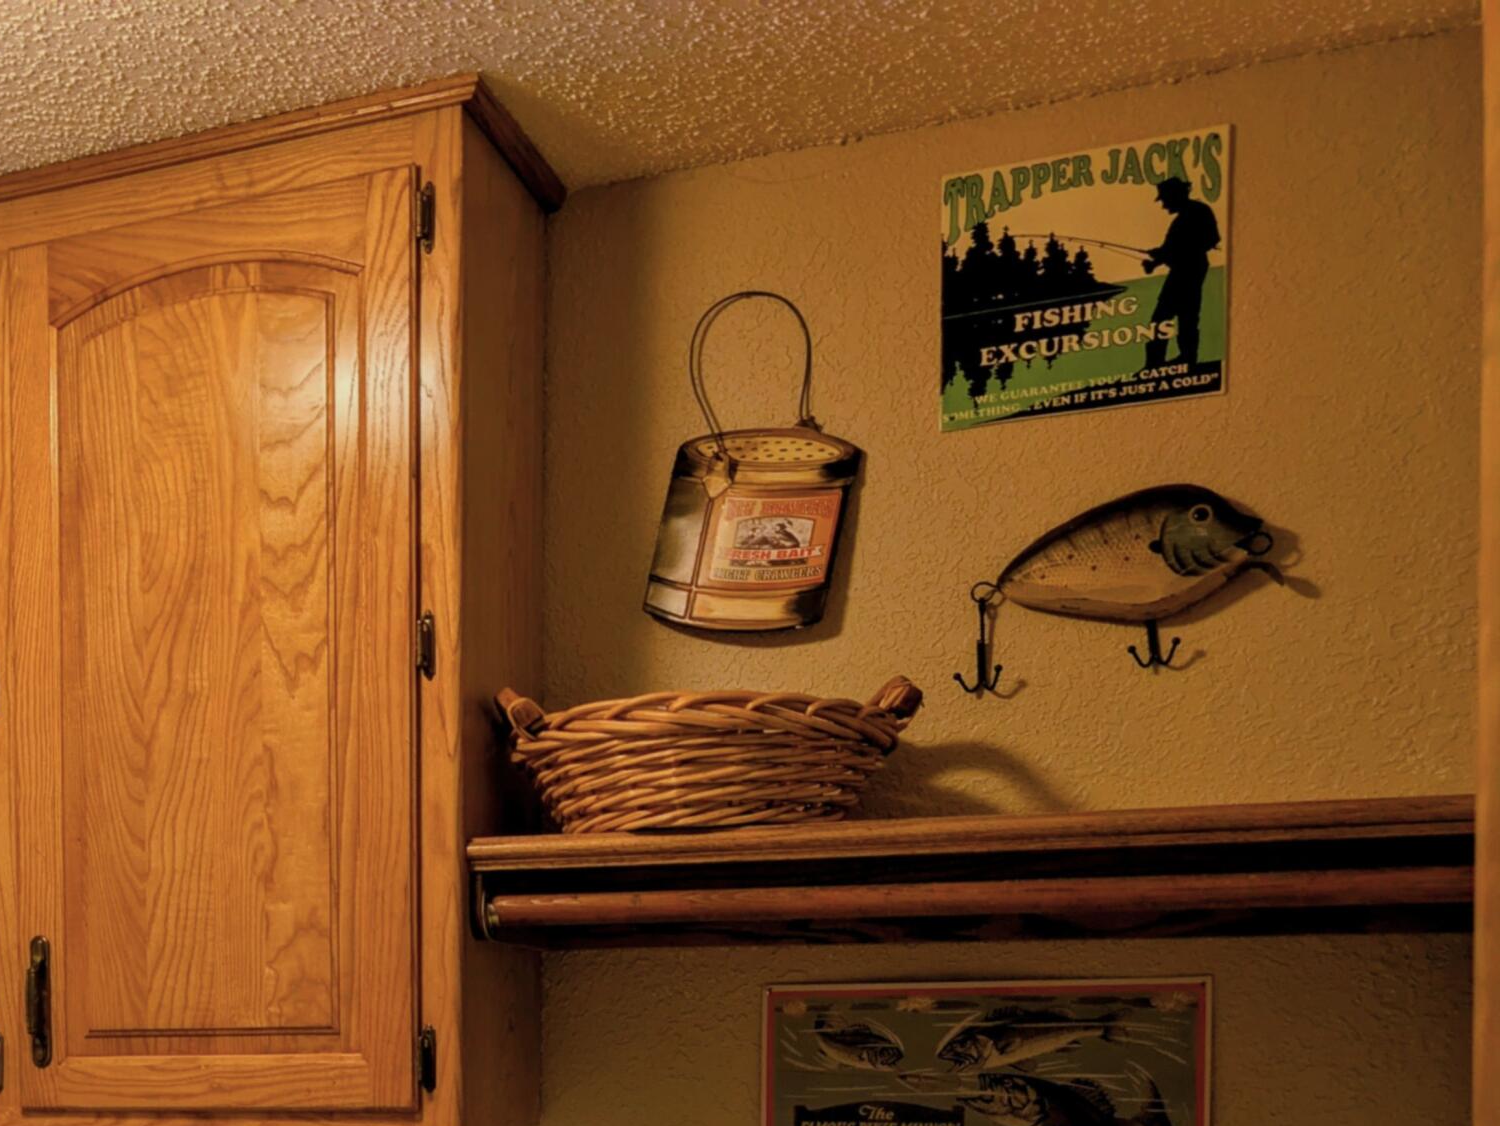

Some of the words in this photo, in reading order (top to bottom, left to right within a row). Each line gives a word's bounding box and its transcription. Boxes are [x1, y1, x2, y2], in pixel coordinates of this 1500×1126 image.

[943, 153, 1095, 247] TRAPPER
[1101, 132, 1223, 203] JACK'S
[1013, 296, 1140, 333] FISHING
[979, 319, 1178, 368] EXCURSIONS
[999, 381, 1083, 402] GUARANTEE
[1139, 363, 1189, 380] CATCH
[1033, 394, 1072, 411] EVEN
[1073, 391, 1089, 404] IF
[1090, 387, 1117, 400] IT'S
[1119, 381, 1157, 397] JUST
[1158, 379, 1170, 391] A
[776, 548, 814, 559] BAIT
[858, 1104, 894, 1120] The
